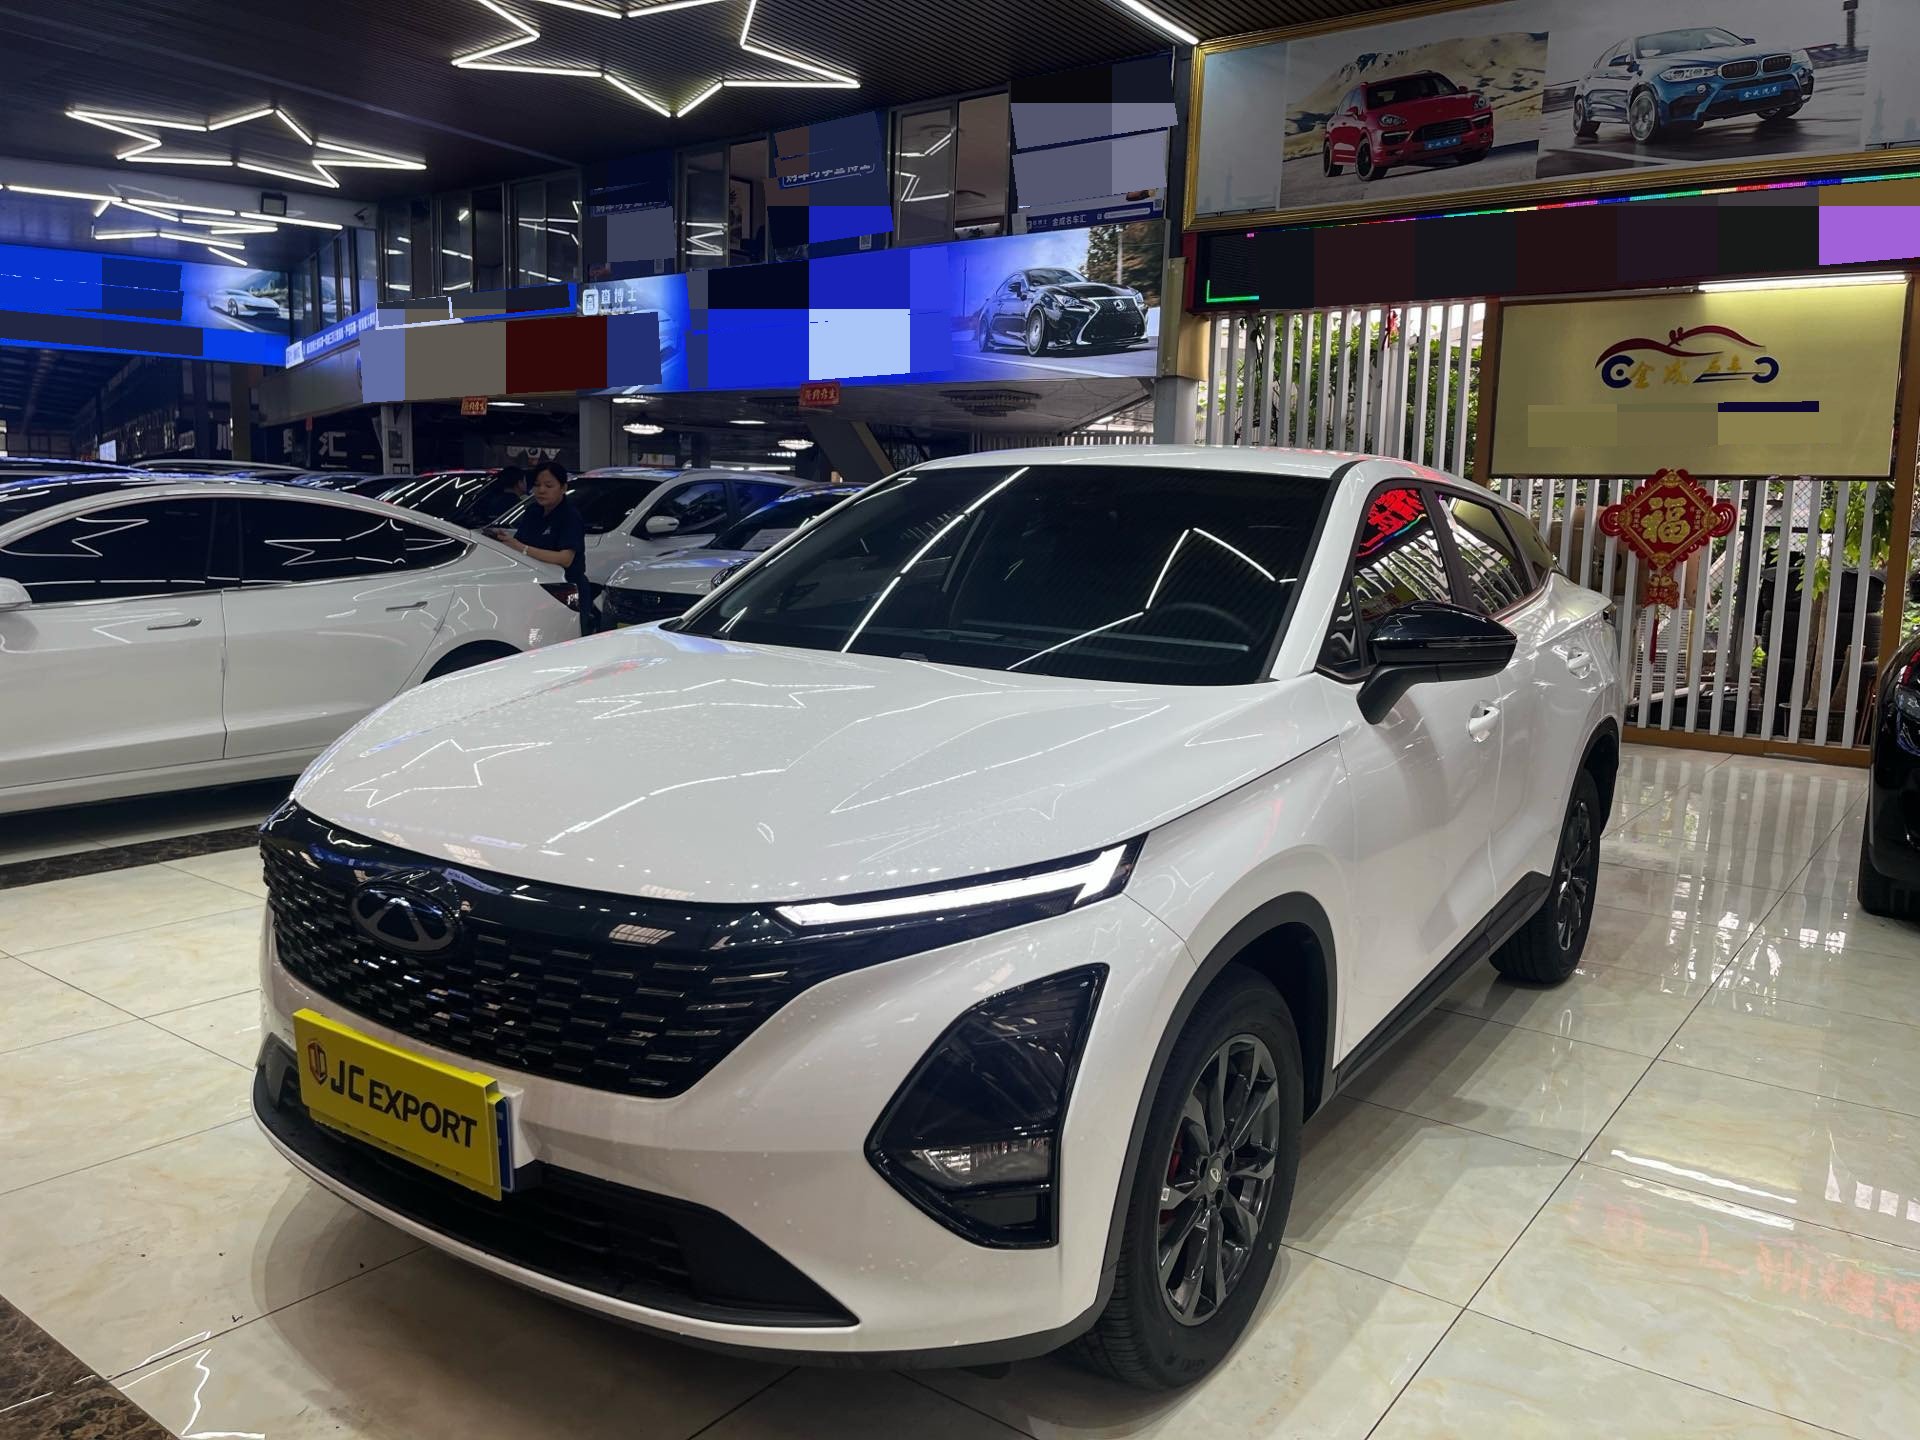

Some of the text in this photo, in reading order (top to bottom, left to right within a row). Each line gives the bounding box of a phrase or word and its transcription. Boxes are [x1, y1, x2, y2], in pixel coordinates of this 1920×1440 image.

[601, 288, 637, 304] 查博士
[1641, 497, 1691, 544] 福
[330, 1059, 477, 1149] JC EXPORT
